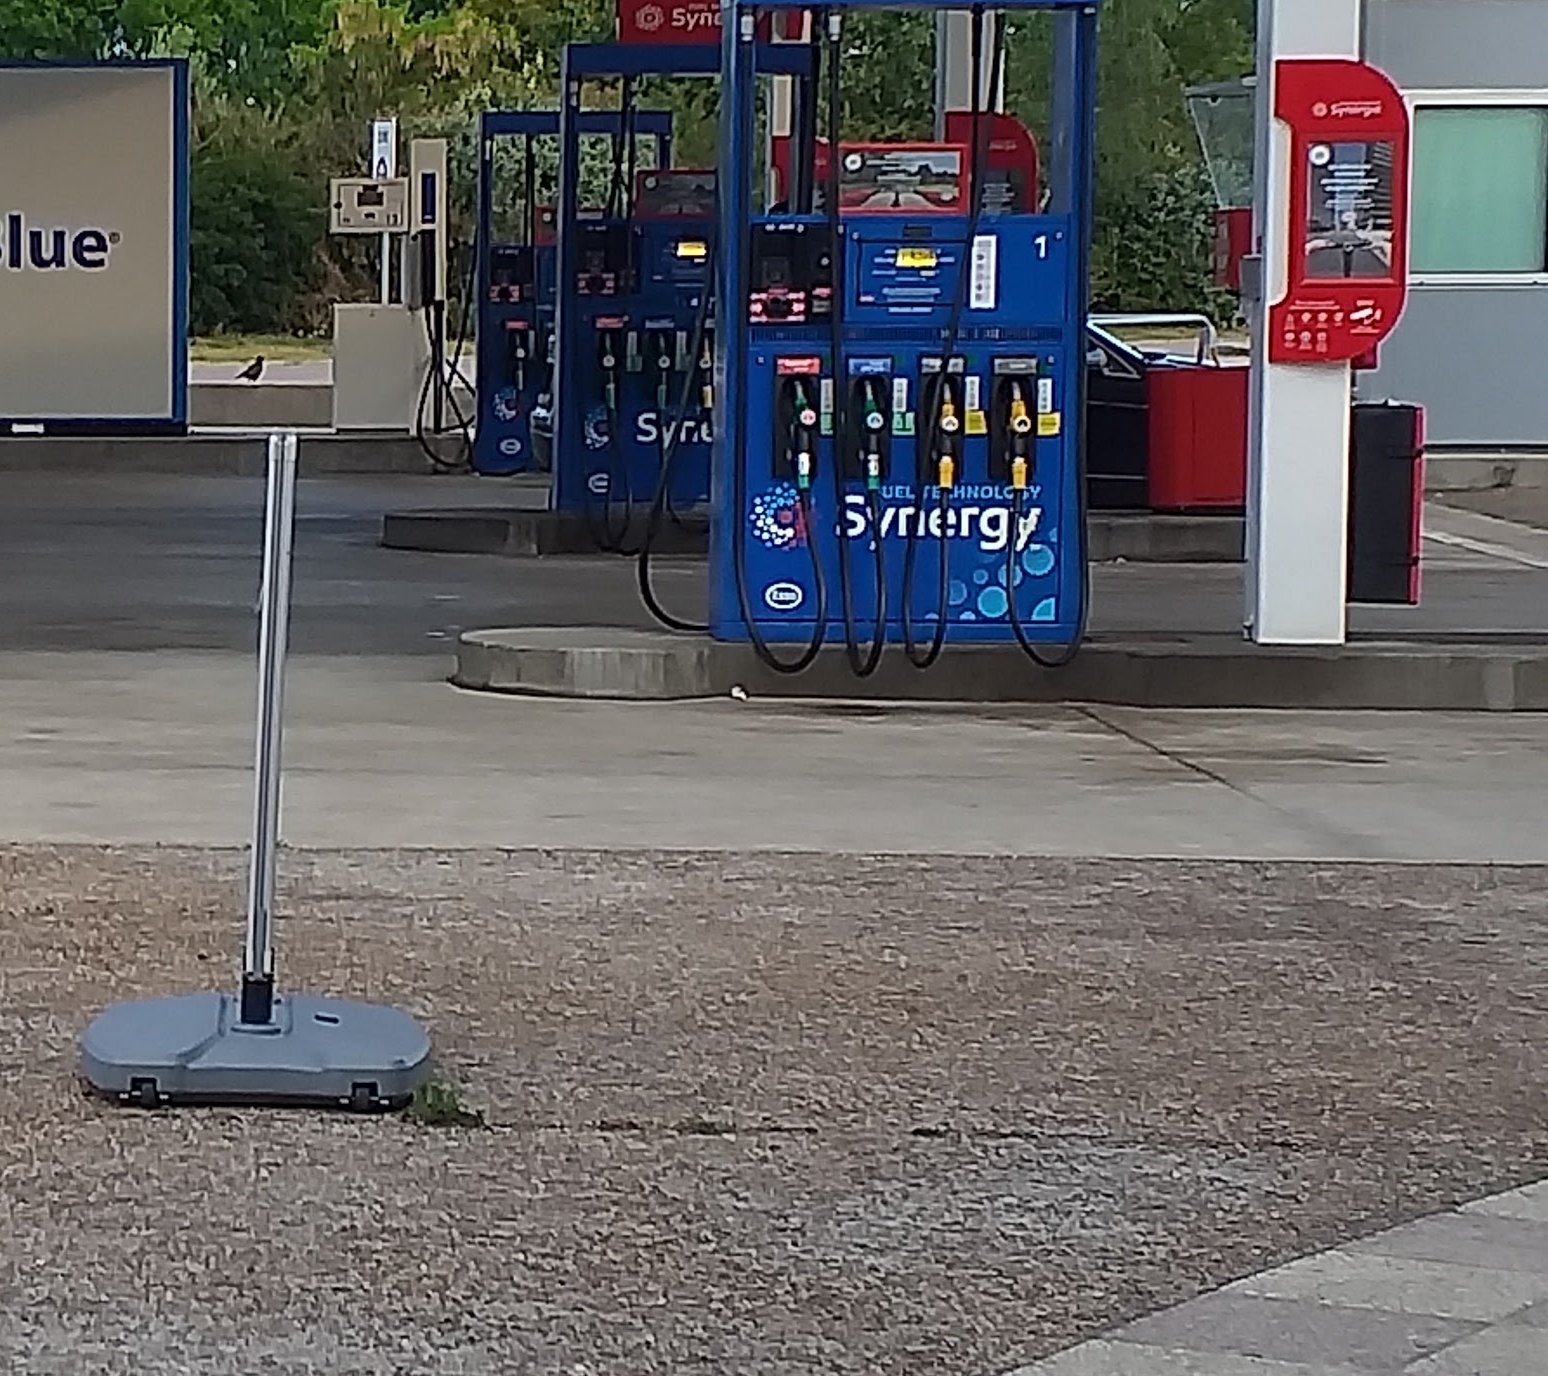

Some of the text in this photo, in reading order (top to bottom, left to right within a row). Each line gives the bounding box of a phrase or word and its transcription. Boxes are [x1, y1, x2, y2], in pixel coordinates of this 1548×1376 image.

[1034, 235, 1047, 259] 1
[879, 485, 916, 500] UEL
[835, 495, 1042, 552] Synergy
